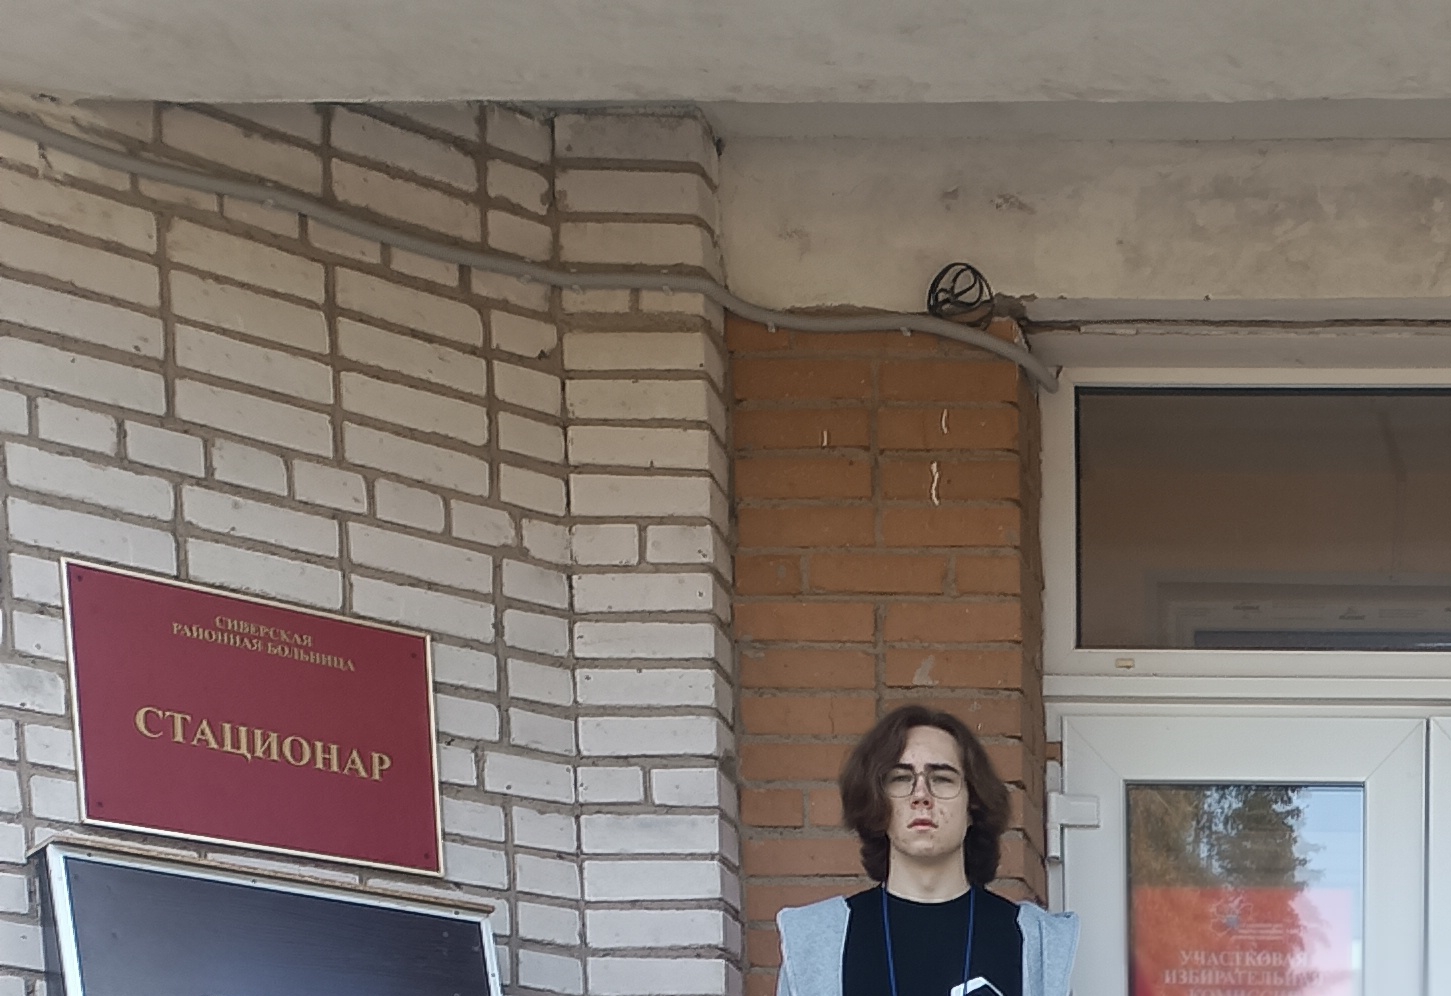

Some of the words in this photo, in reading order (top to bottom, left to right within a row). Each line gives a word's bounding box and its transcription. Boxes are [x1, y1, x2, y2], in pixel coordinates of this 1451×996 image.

[172, 622, 262, 652] РАЙОННАЯ
[268, 642, 355, 672] БОЛЬНИЦА
[215, 615, 313, 647] СИВЕРСКАЯ
[134, 706, 392, 781] СТАЦИОНАР
